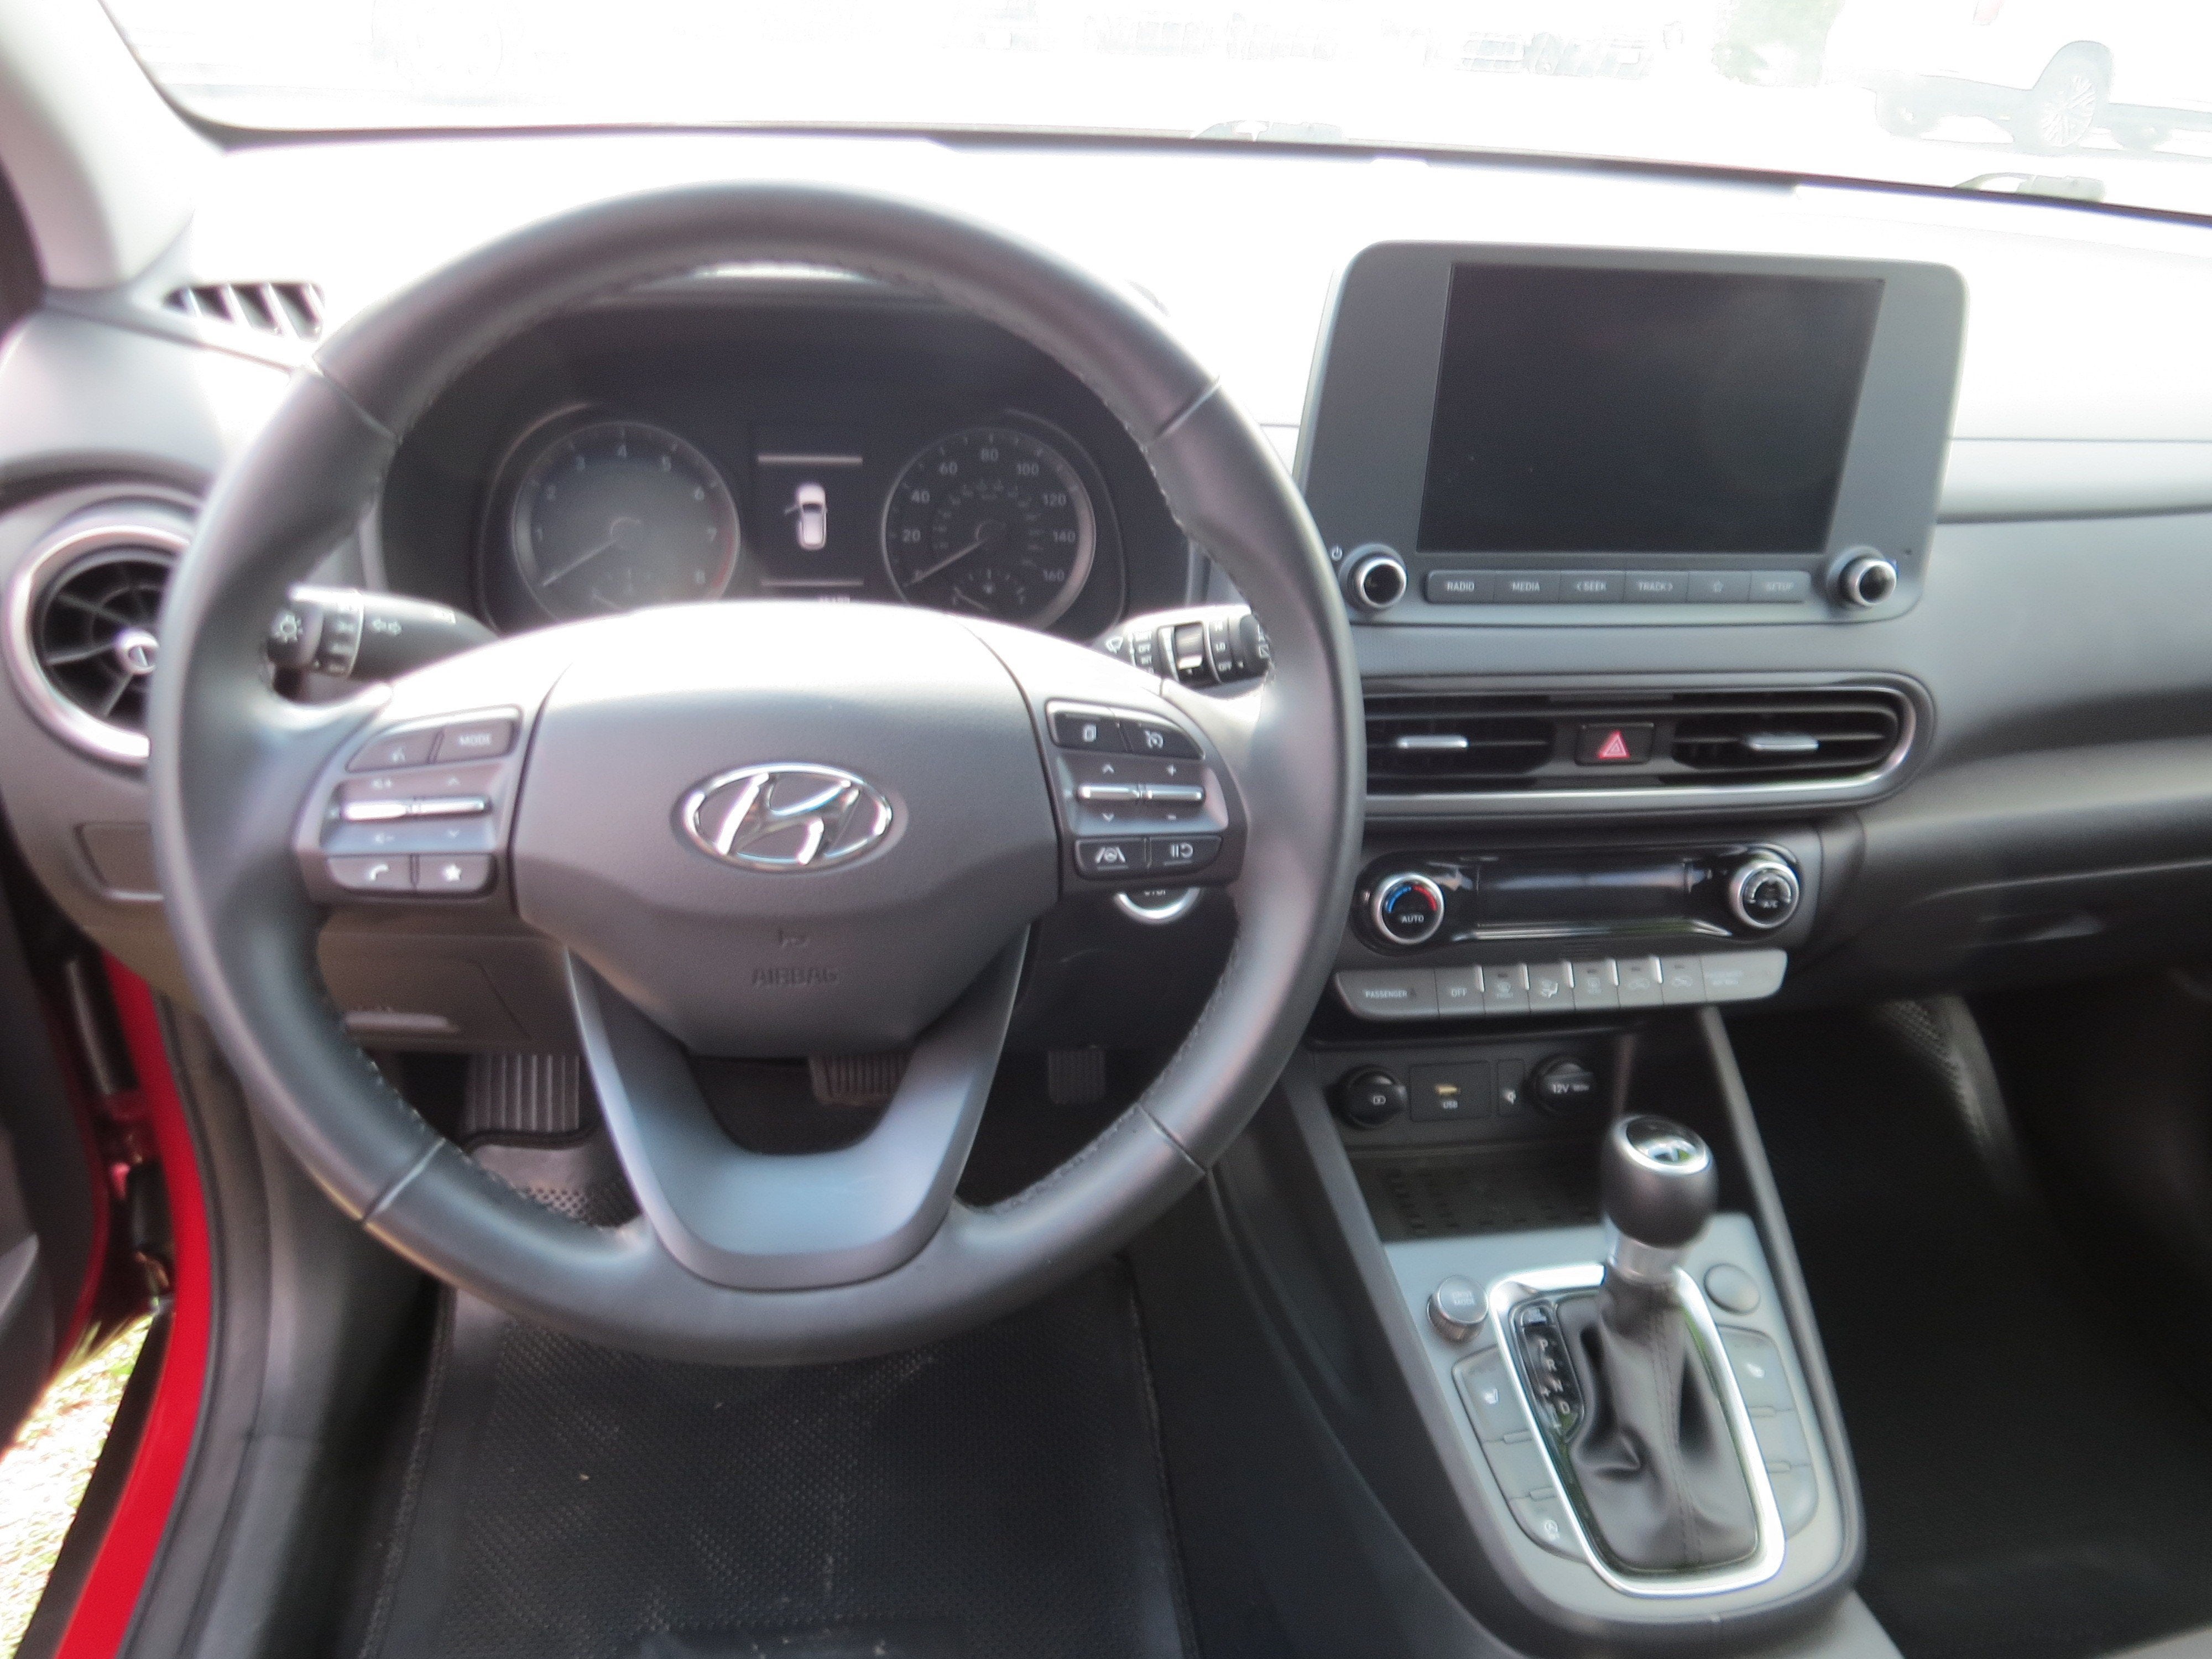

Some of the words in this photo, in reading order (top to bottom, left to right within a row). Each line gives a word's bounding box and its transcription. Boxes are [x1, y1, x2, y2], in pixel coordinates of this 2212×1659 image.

[980, 448, 999, 462] 80
[938, 461, 958, 476] 60
[1016, 462, 1039, 477] 100
[910, 489, 930, 504] 40
[1042, 493, 1066, 507] 120
[902, 528, 921, 543] 20
[1052, 530, 1076, 543] 140
[1042, 569, 1065, 582] 160
[1447, 581, 1475, 592] RADIO
[1512, 581, 1540, 592] MEDIA
[458, 733, 492, 747] MODE
[1402, 915, 1425, 924] AUTO
[750, 967, 839, 987] AIRBAG
[1365, 989, 1408, 999] PASSENGER
[1552, 1083, 1569, 1094] 12V
[1443, 1100, 1458, 1109] USB
